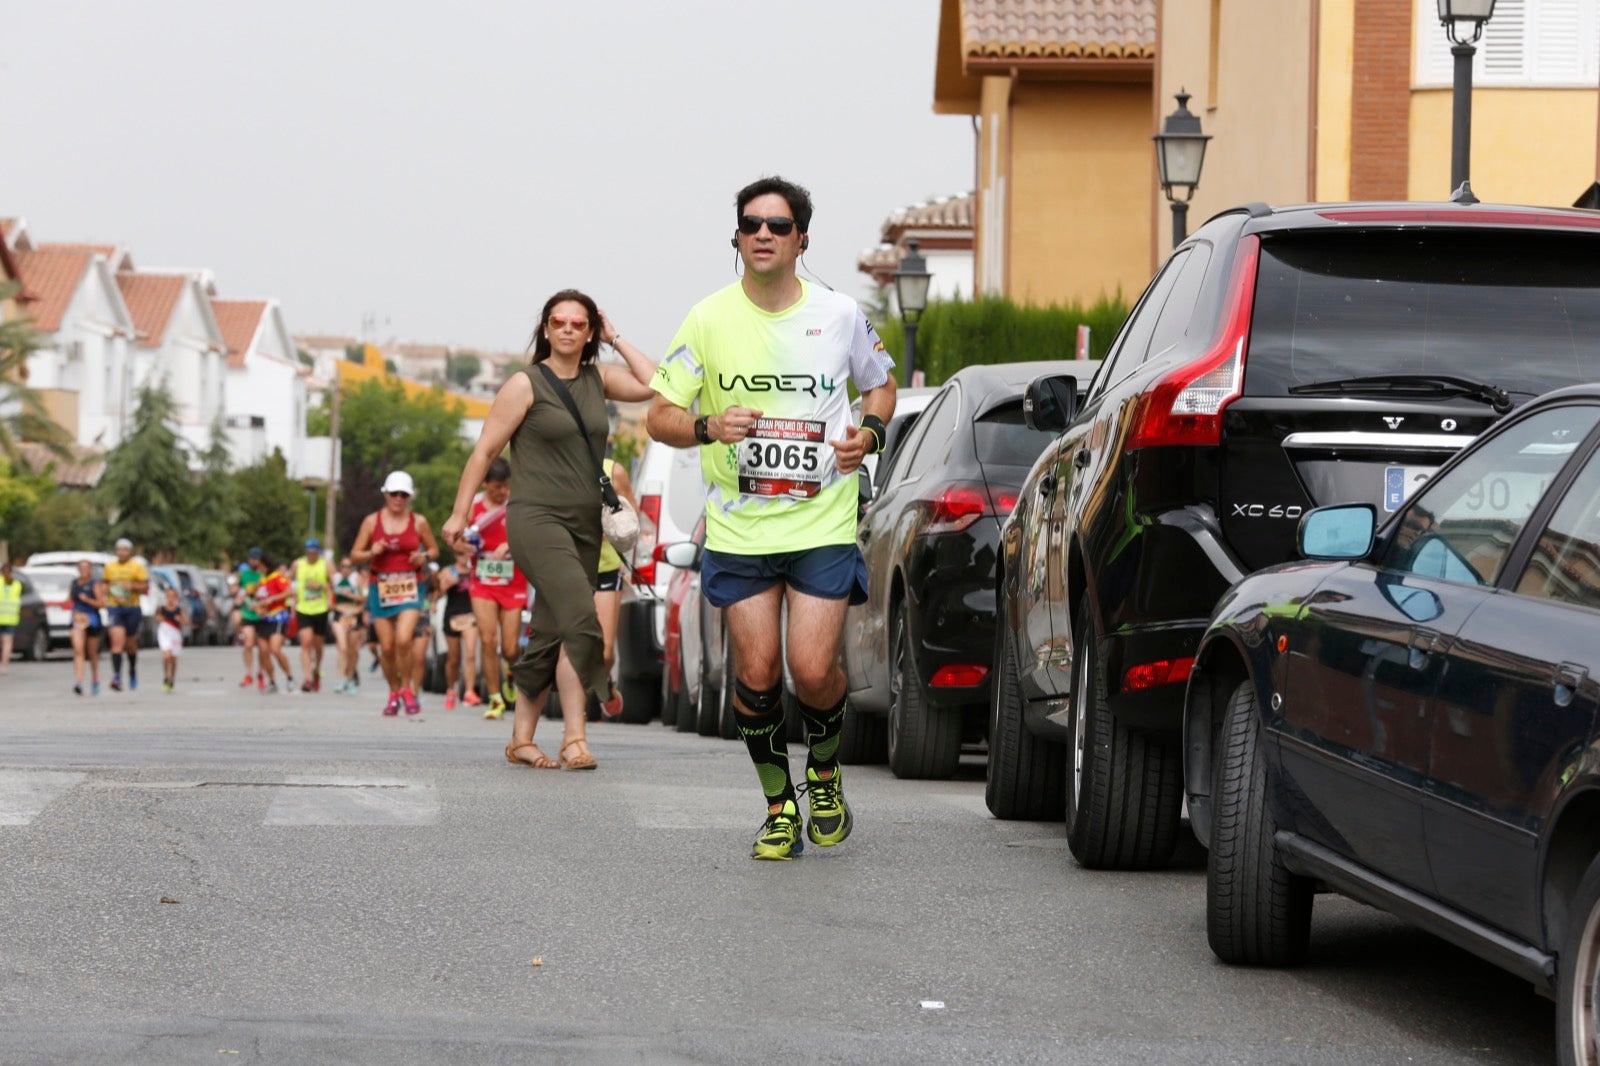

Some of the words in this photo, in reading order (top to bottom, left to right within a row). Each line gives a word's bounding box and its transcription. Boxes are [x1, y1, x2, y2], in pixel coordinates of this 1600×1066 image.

[757, 419, 774, 430] GRAN
[774, 420, 796, 432] PREMIO
[797, 422, 804, 432] DE
[804, 422, 822, 434] FONDO
[747, 442, 818, 472] 3065
[1391, 493, 1400, 503] E
[486, 563, 504, 574] 68
